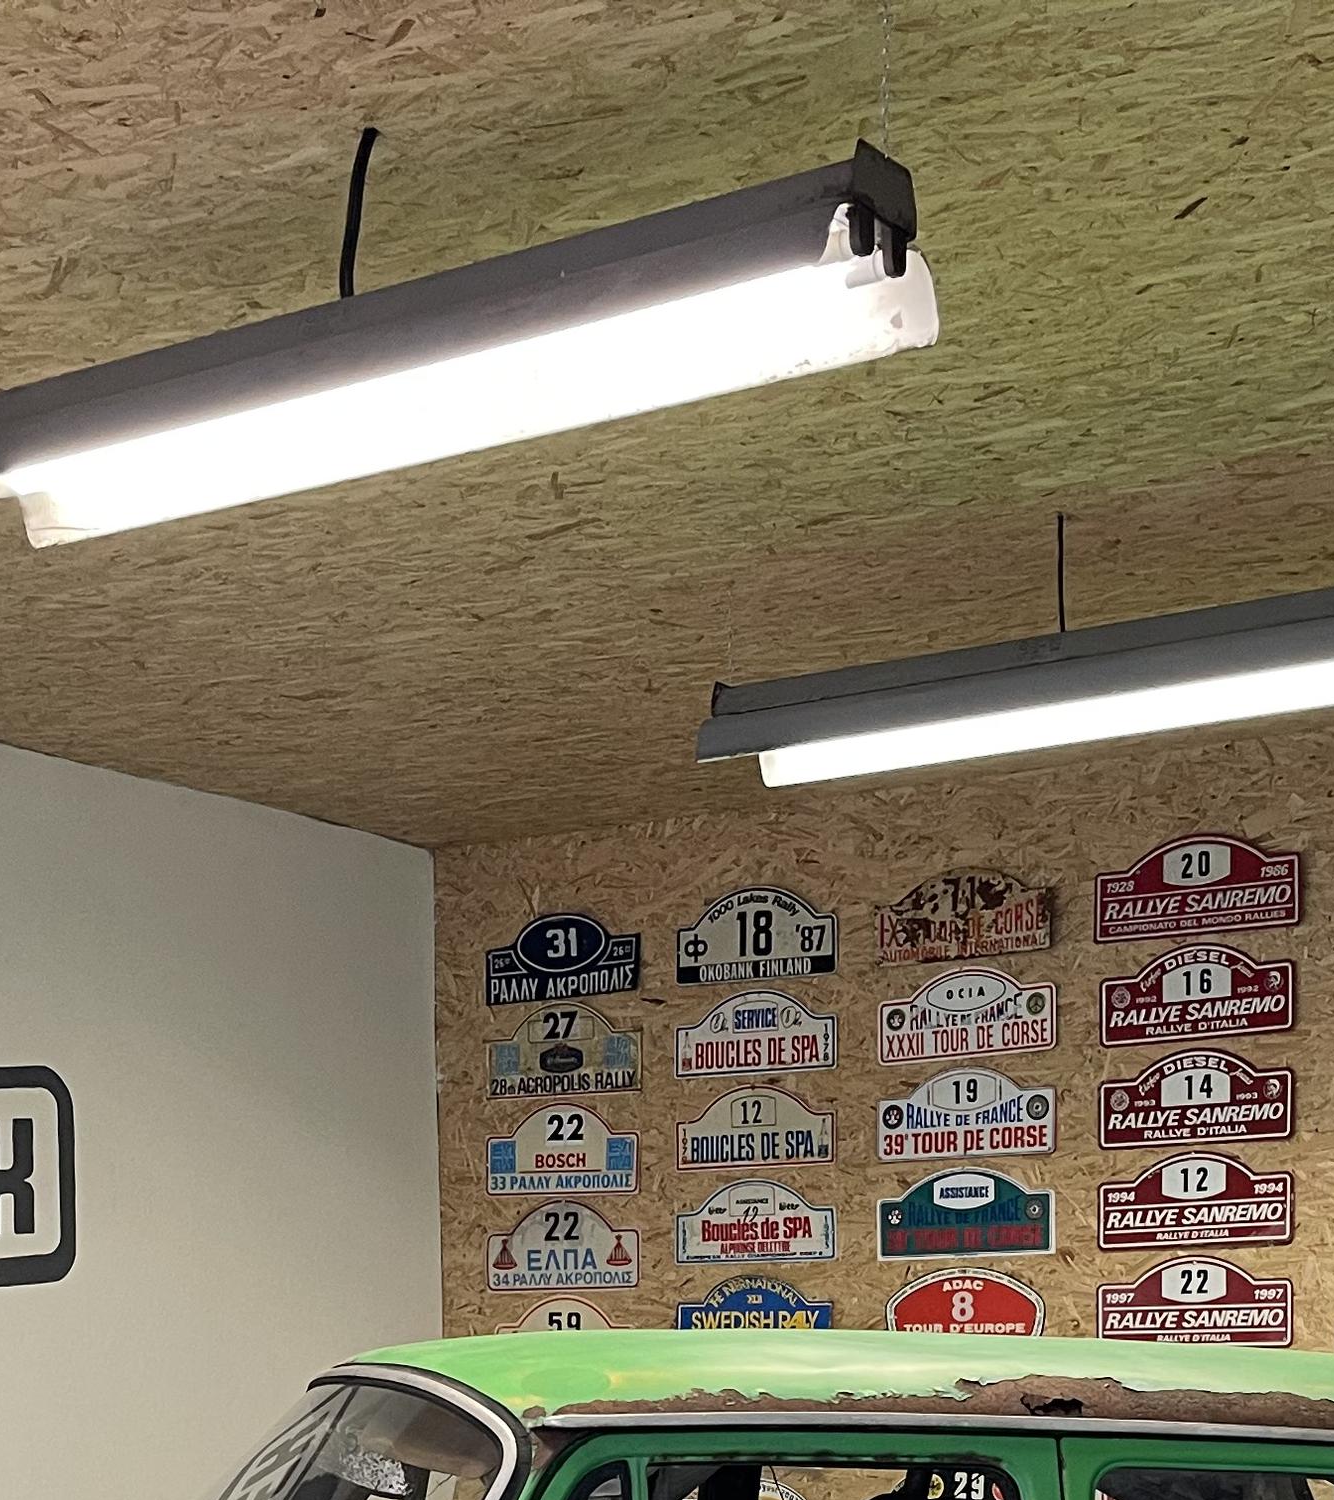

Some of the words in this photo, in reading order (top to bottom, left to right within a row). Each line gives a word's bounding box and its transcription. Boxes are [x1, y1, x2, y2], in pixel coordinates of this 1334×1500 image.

[1181, 851, 1210, 880] 20
[1103, 895, 1181, 921] RALLYE
[1184, 883, 1292, 911] SANREMO
[547, 927, 578, 958] 31
[737, 910, 773, 956] 18
[1182, 968, 1212, 996] 16
[734, 1006, 777, 1029] SERVICE
[1108, 1006, 1181, 1028] RALLYE
[1185, 994, 1286, 1021] SANREMO
[542, 1011, 578, 1039] 27
[695, 1038, 761, 1068] BOUCLES
[768, 1037, 786, 1064] DE
[791, 1035, 818, 1063] SPA
[952, 1079, 978, 1104] 19
[1184, 1074, 1213, 1100] 14
[741, 1100, 762, 1125] 12
[906, 1103, 951, 1129] RALLYE
[956, 1113, 972, 1127] DE
[975, 1098, 1024, 1124] FRANCE
[1108, 1110, 1180, 1130] RALLYE
[1184, 1102, 1283, 1124] SANREMO
[547, 1114, 583, 1141] 22
[911, 1131, 959, 1154] TOUR
[965, 1130, 983, 1152] DE
[990, 1124, 1047, 1149] CORSE
[691, 1133, 755, 1163] BOUCLES
[761, 1132, 778, 1160] DE
[786, 1130, 813, 1158] SPA
[535, 1153, 586, 1168] BOSCH
[491, 1175, 506, 1189] 33
[510, 1174, 552, 1190] ΡΑΛΛΥ
[556, 1174, 632, 1189] ΑΚΡΟΠΟΛΙΣ
[1181, 1167, 1208, 1193] 12
[1254, 1182, 1283, 1194] 1994
[1107, 1190, 1135, 1203] 1994
[544, 1212, 578, 1241] 22
[702, 1218, 758, 1242] Boucles
[760, 1220, 777, 1240] de
[782, 1216, 812, 1238] SPA
[1107, 1209, 1177, 1229] RALLYE
[1181, 1203, 1282, 1224] SANREMO
[527, 1249, 597, 1270] ΕΛΠΑ
[942, 1279, 983, 1291] ADAC
[1181, 1270, 1208, 1294] 22
[952, 1291, 974, 1321] 8
[1105, 1309, 1177, 1329] RALLYE
[1181, 1307, 1283, 1328] SANREMO
[954, 1472, 985, 1500] 29
